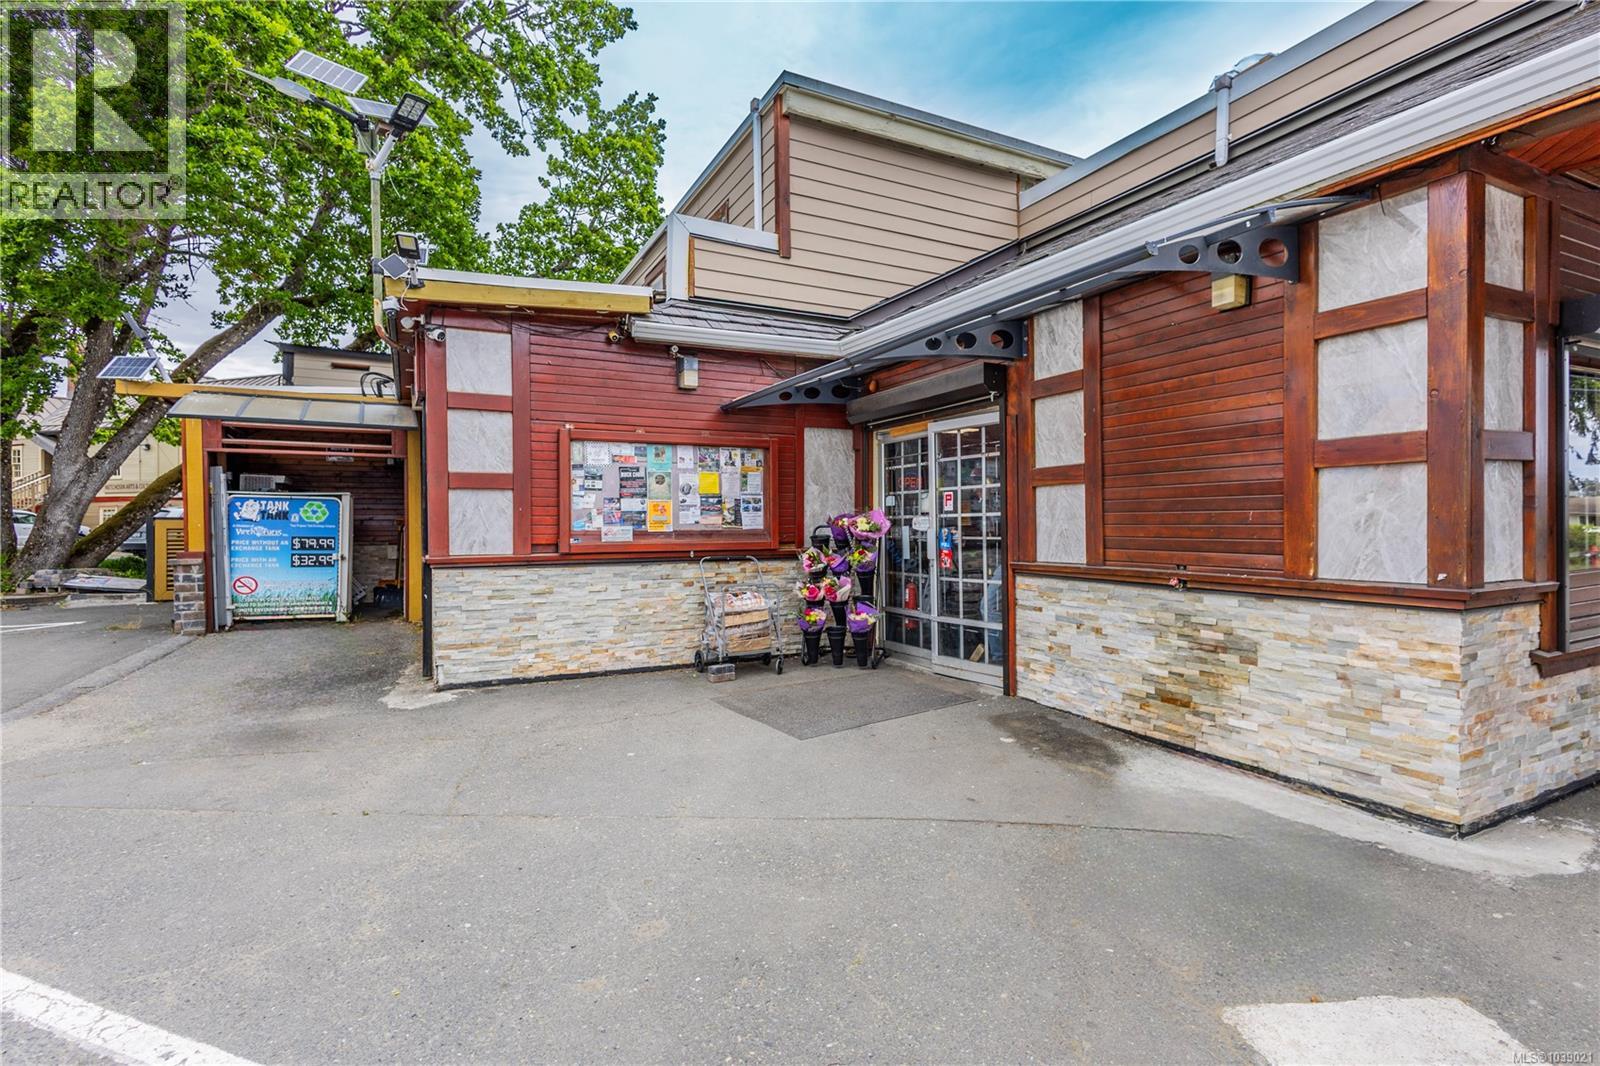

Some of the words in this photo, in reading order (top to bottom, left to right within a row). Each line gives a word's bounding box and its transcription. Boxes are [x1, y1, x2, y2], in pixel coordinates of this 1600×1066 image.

[260, 501, 290, 511] TANK
[261, 510, 289, 520] TANK
[292, 538, 335, 549] $79.99
[292, 555, 334, 567] $32.99
